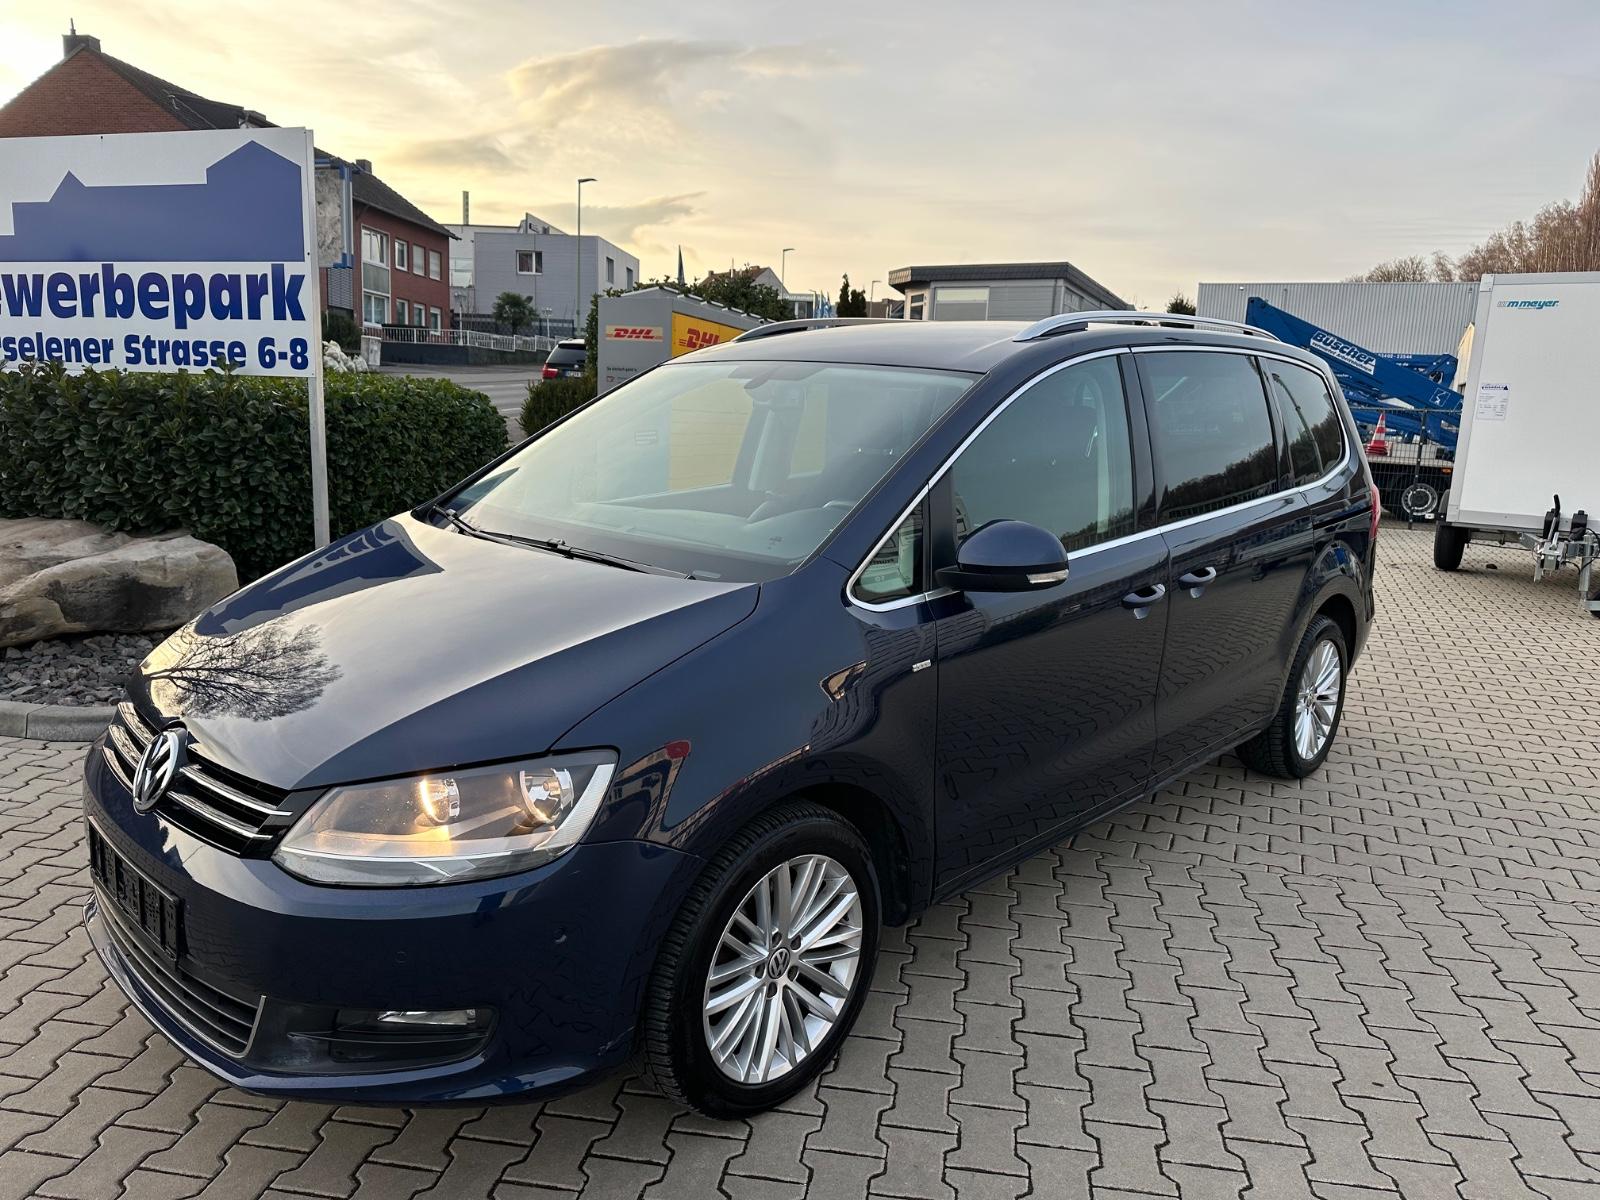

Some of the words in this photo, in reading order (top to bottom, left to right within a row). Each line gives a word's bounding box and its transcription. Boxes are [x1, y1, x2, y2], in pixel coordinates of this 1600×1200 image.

[0, 263, 305, 329] werbepark
[0, 332, 114, 364] selener
[124, 334, 246, 368] Strasse
[258, 337, 309, 370] 6-8
[614, 328, 655, 339] DHL
